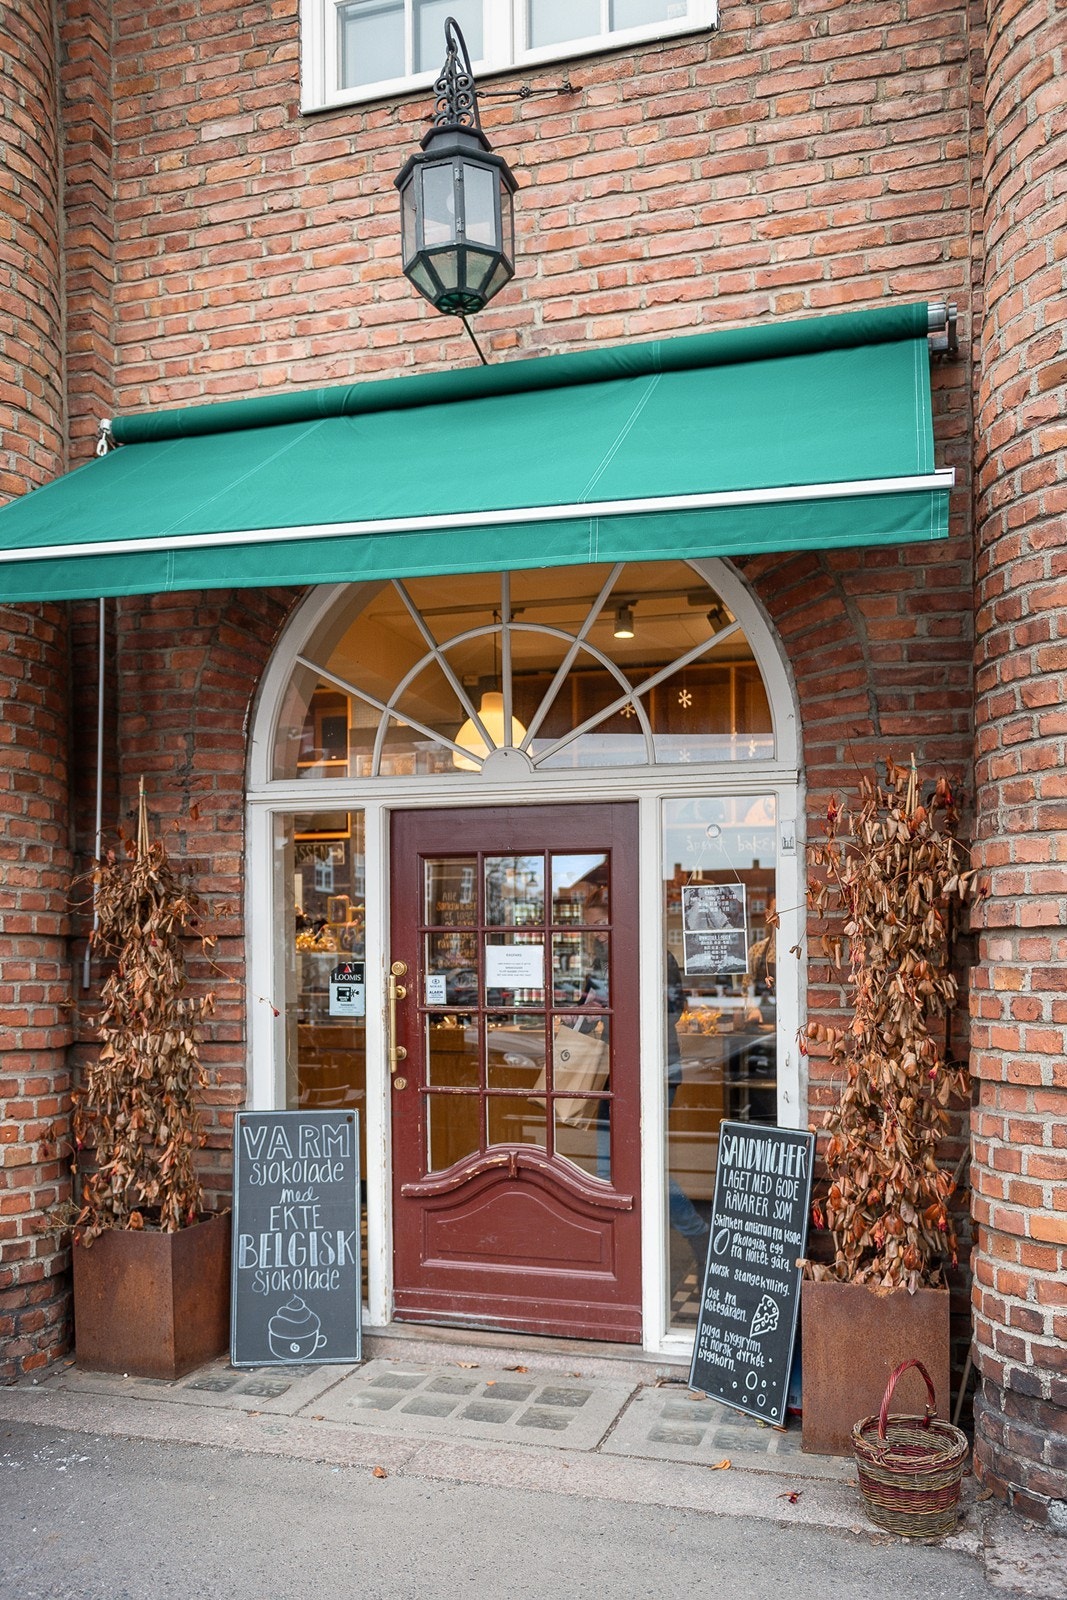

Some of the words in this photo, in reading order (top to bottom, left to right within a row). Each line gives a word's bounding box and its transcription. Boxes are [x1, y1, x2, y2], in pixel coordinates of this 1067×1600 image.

[334, 973, 362, 981] LOOMIS
[243, 1124, 350, 1160] VARM
[723, 1168, 751, 1191] LAGET
[751, 1172, 772, 1194] MED
[775, 1178, 799, 1201] GODE
[279, 1187, 319, 1204] med
[725, 1190, 768, 1218] RÅVARER
[773, 1200, 793, 1223] SOM
[270, 1205, 323, 1231] EKTE
[239, 1231, 355, 1269] BELGISK
[731, 1244, 742, 1259] fra
[770, 1242, 784, 1254] egg
[709, 1262, 730, 1278] Norsk
[707, 1287, 720, 1300] Ost
[724, 1291, 736, 1306] fra
[700, 1336, 708, 1348] et
[710, 1339, 732, 1357] norsk
